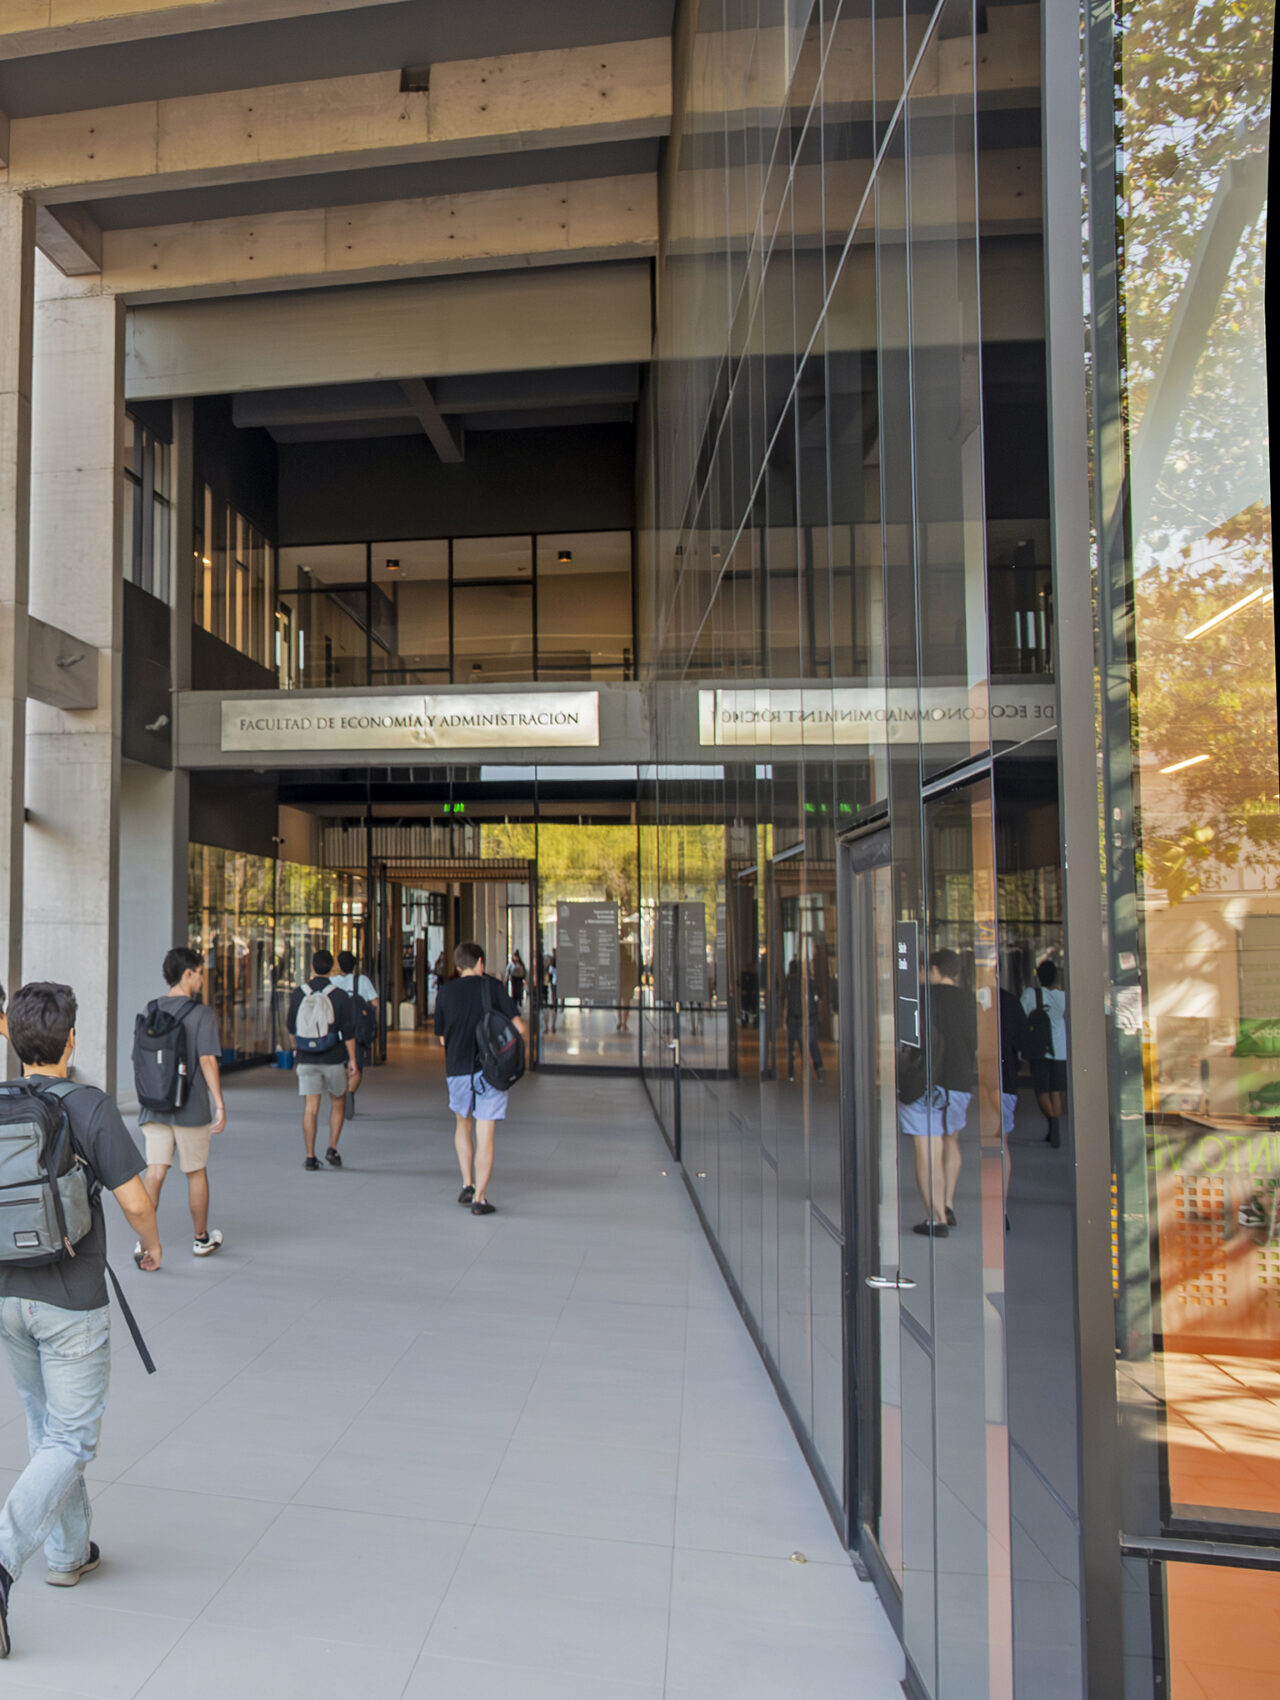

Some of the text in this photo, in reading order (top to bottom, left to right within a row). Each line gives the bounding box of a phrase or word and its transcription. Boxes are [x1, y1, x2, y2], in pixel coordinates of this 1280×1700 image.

[239, 710, 579, 731] FACULTAD DE ECONOMÍA Y ADMINISTRACIÓN
